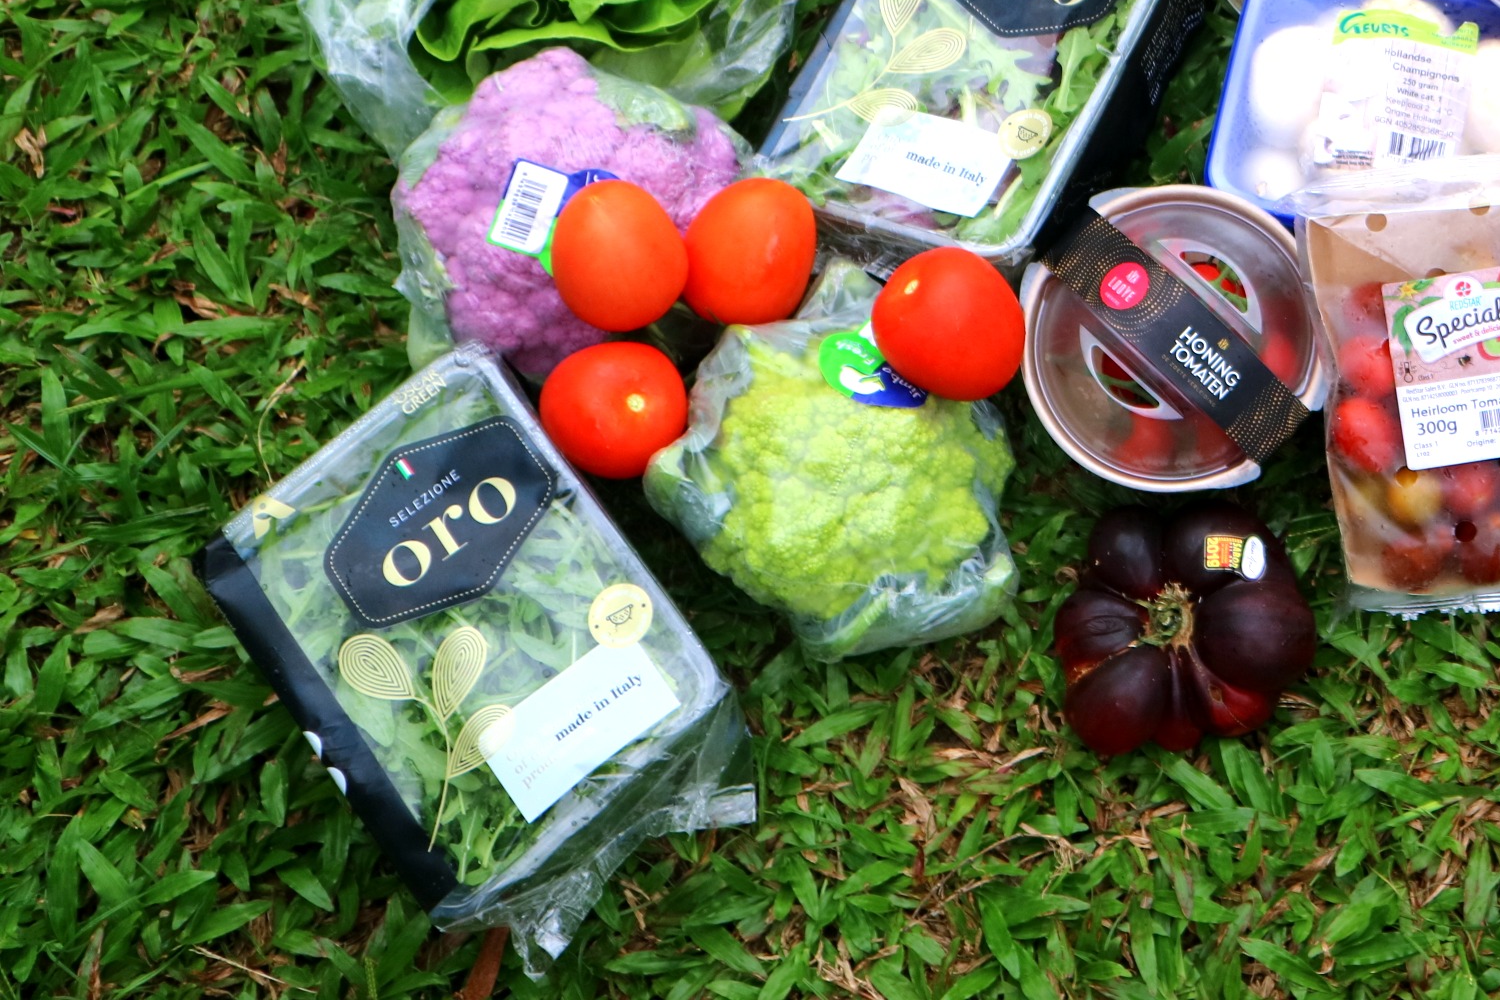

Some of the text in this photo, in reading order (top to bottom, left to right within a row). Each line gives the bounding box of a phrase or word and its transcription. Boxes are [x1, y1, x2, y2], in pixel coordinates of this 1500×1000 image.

[1384, 47, 1432, 64] Hollandse
[1392, 61, 1460, 83] Champignons
[1402, 77, 1439, 91] 250 gram
[1396, 86, 1419, 98] White
[1384, 106, 1442, 126] Origine Holland
[905, 150, 987, 187] made in Italy
[1107, 275, 1136, 303] LOOYE
[1452, 332, 1474, 345] sweet
[836, 340, 876, 366] Fresh
[1179, 326, 1240, 387] HONING
[882, 366, 922, 398] Jimbo
[1169, 339, 1230, 400] TOMATEN
[401, 376, 447, 414] GREEN
[1410, 402, 1468, 419] Heirloom
[1416, 419, 1459, 437] 300g
[1413, 442, 1433, 451] Class
[1466, 437, 1497, 448] Origine:
[388, 469, 461, 528] SELEZIONE
[382, 476, 517, 587] oro
[1206, 537, 1220, 568] 2019
[554, 673, 643, 742] made in Italy
